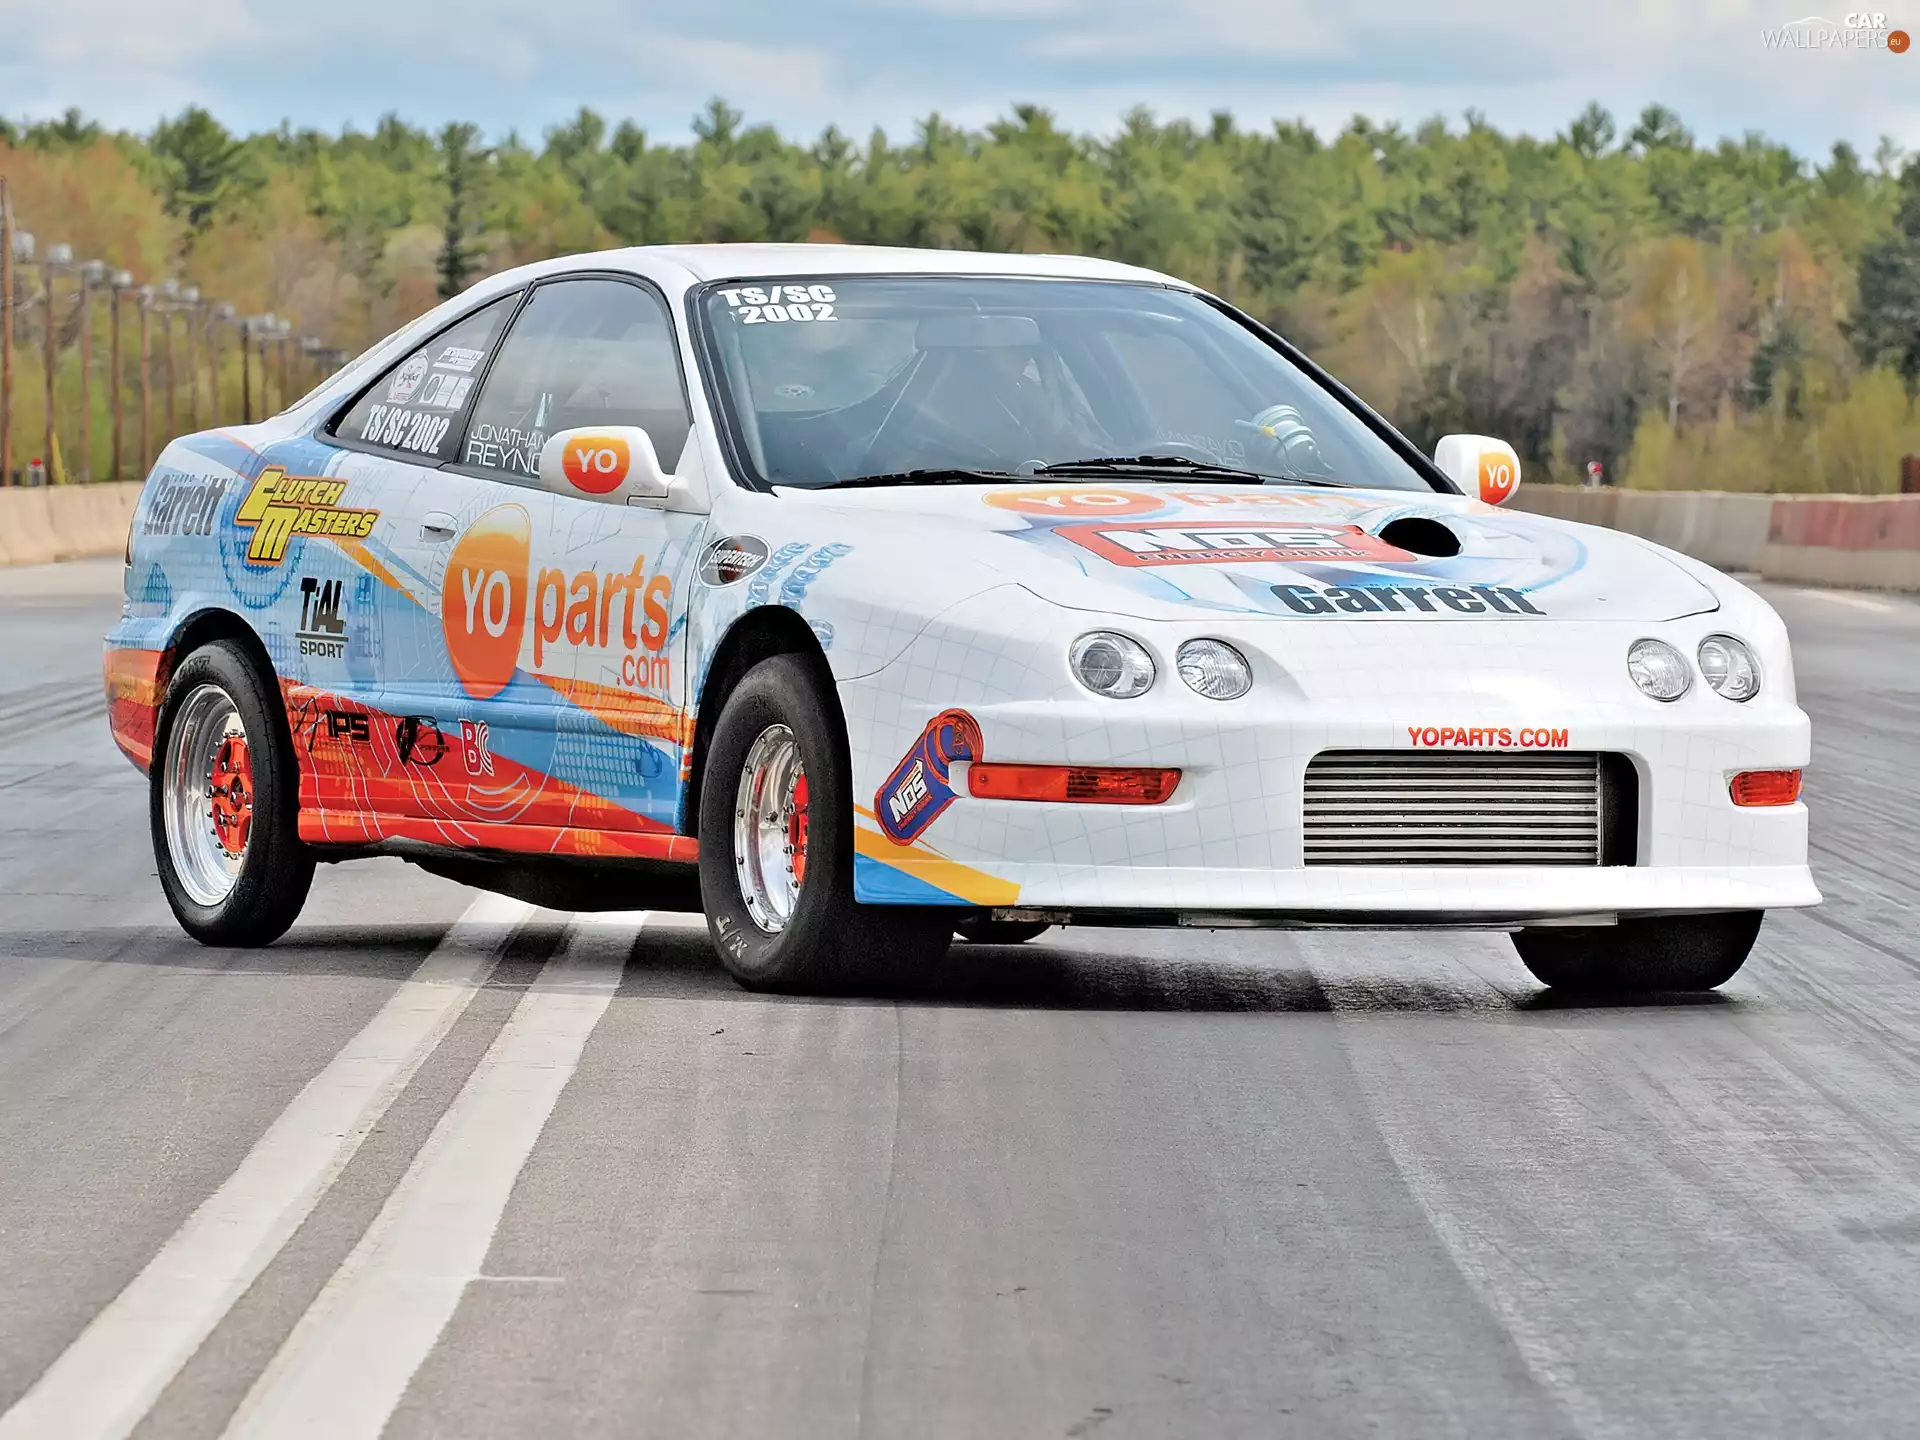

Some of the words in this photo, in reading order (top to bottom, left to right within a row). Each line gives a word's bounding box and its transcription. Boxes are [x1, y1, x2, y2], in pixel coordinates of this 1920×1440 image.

[717, 285, 837, 307] TS/SC
[738, 303, 839, 324] 2002
[360, 404, 412, 446] TS/SC
[402, 413, 450, 454] 2002
[575, 448, 618, 473] YO
[1485, 463, 1510, 482] YO
[143, 474, 228, 536] Garrett
[236, 468, 347, 521] CLUTCH
[1018, 490, 1132, 508] YO
[248, 505, 379, 561] MASTERS
[1090, 526, 1352, 554] NOS
[461, 567, 511, 638] YO
[533, 553, 672, 669] parts
[1269, 583, 1548, 615] Garrett
[299, 641, 345, 659] SPORT
[616, 652, 670, 690] .com
[1408, 726, 1568, 748] YOPARTS.COM
[888, 760, 928, 824] NOS
